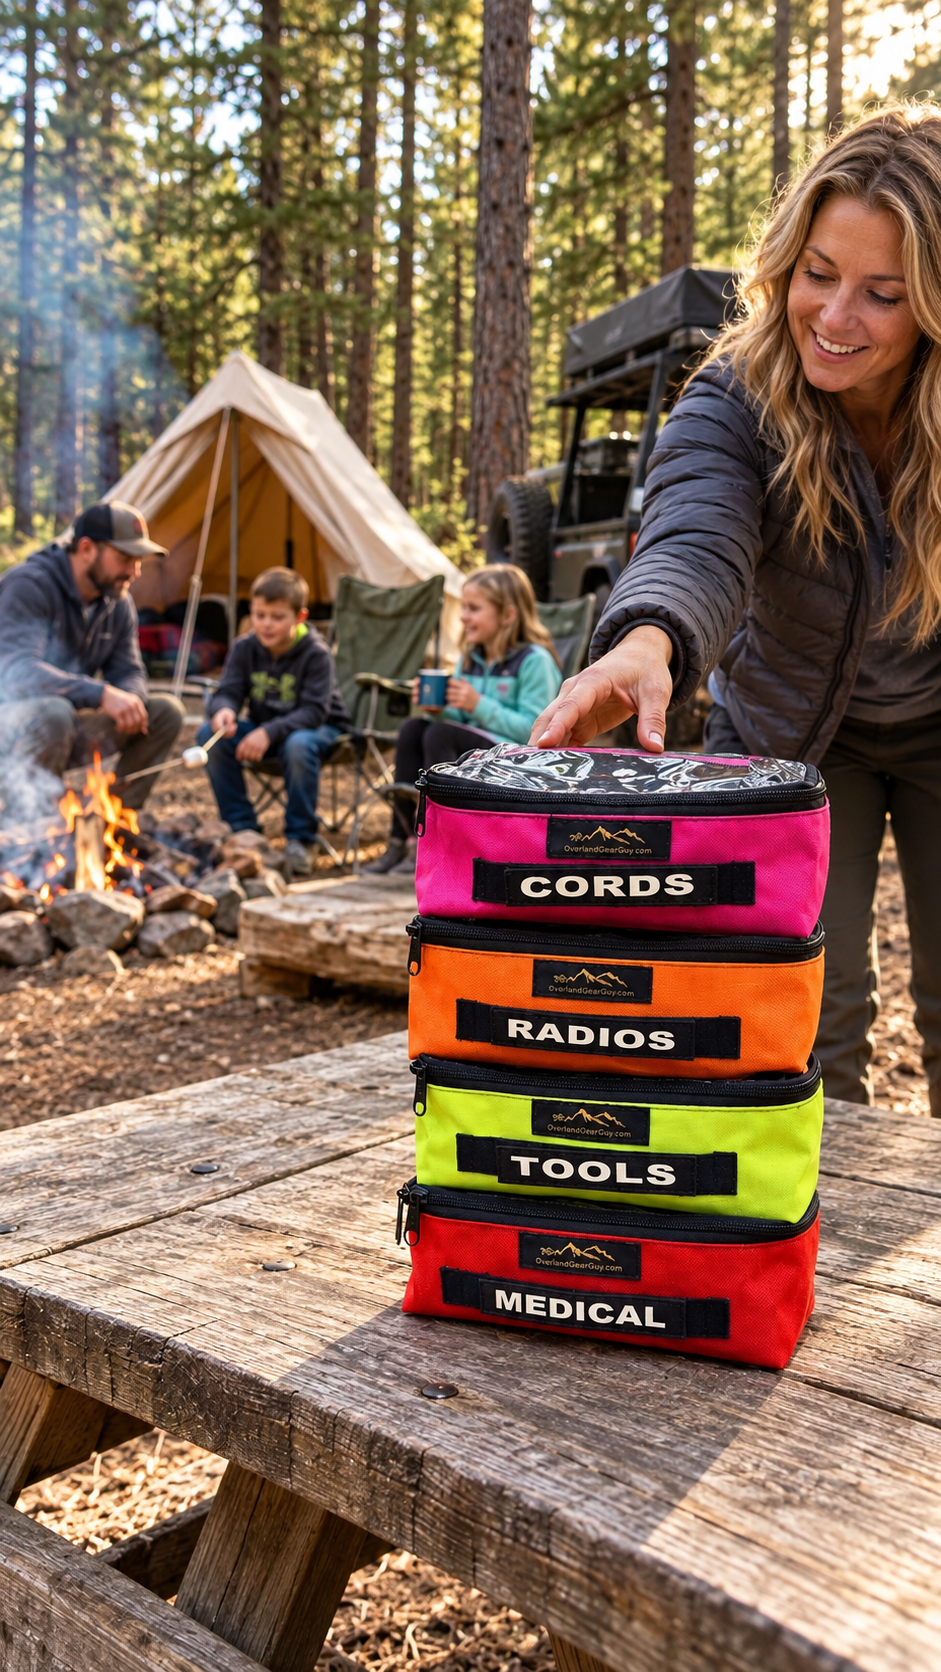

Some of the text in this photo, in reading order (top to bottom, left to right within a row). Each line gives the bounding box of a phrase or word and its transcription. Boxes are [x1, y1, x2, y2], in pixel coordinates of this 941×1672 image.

[521, 874, 694, 898] CORDS
[507, 1018, 676, 1051] RADIOS
[510, 1155, 676, 1186] TOOLS
[496, 1289, 666, 1328] MEDICAL
